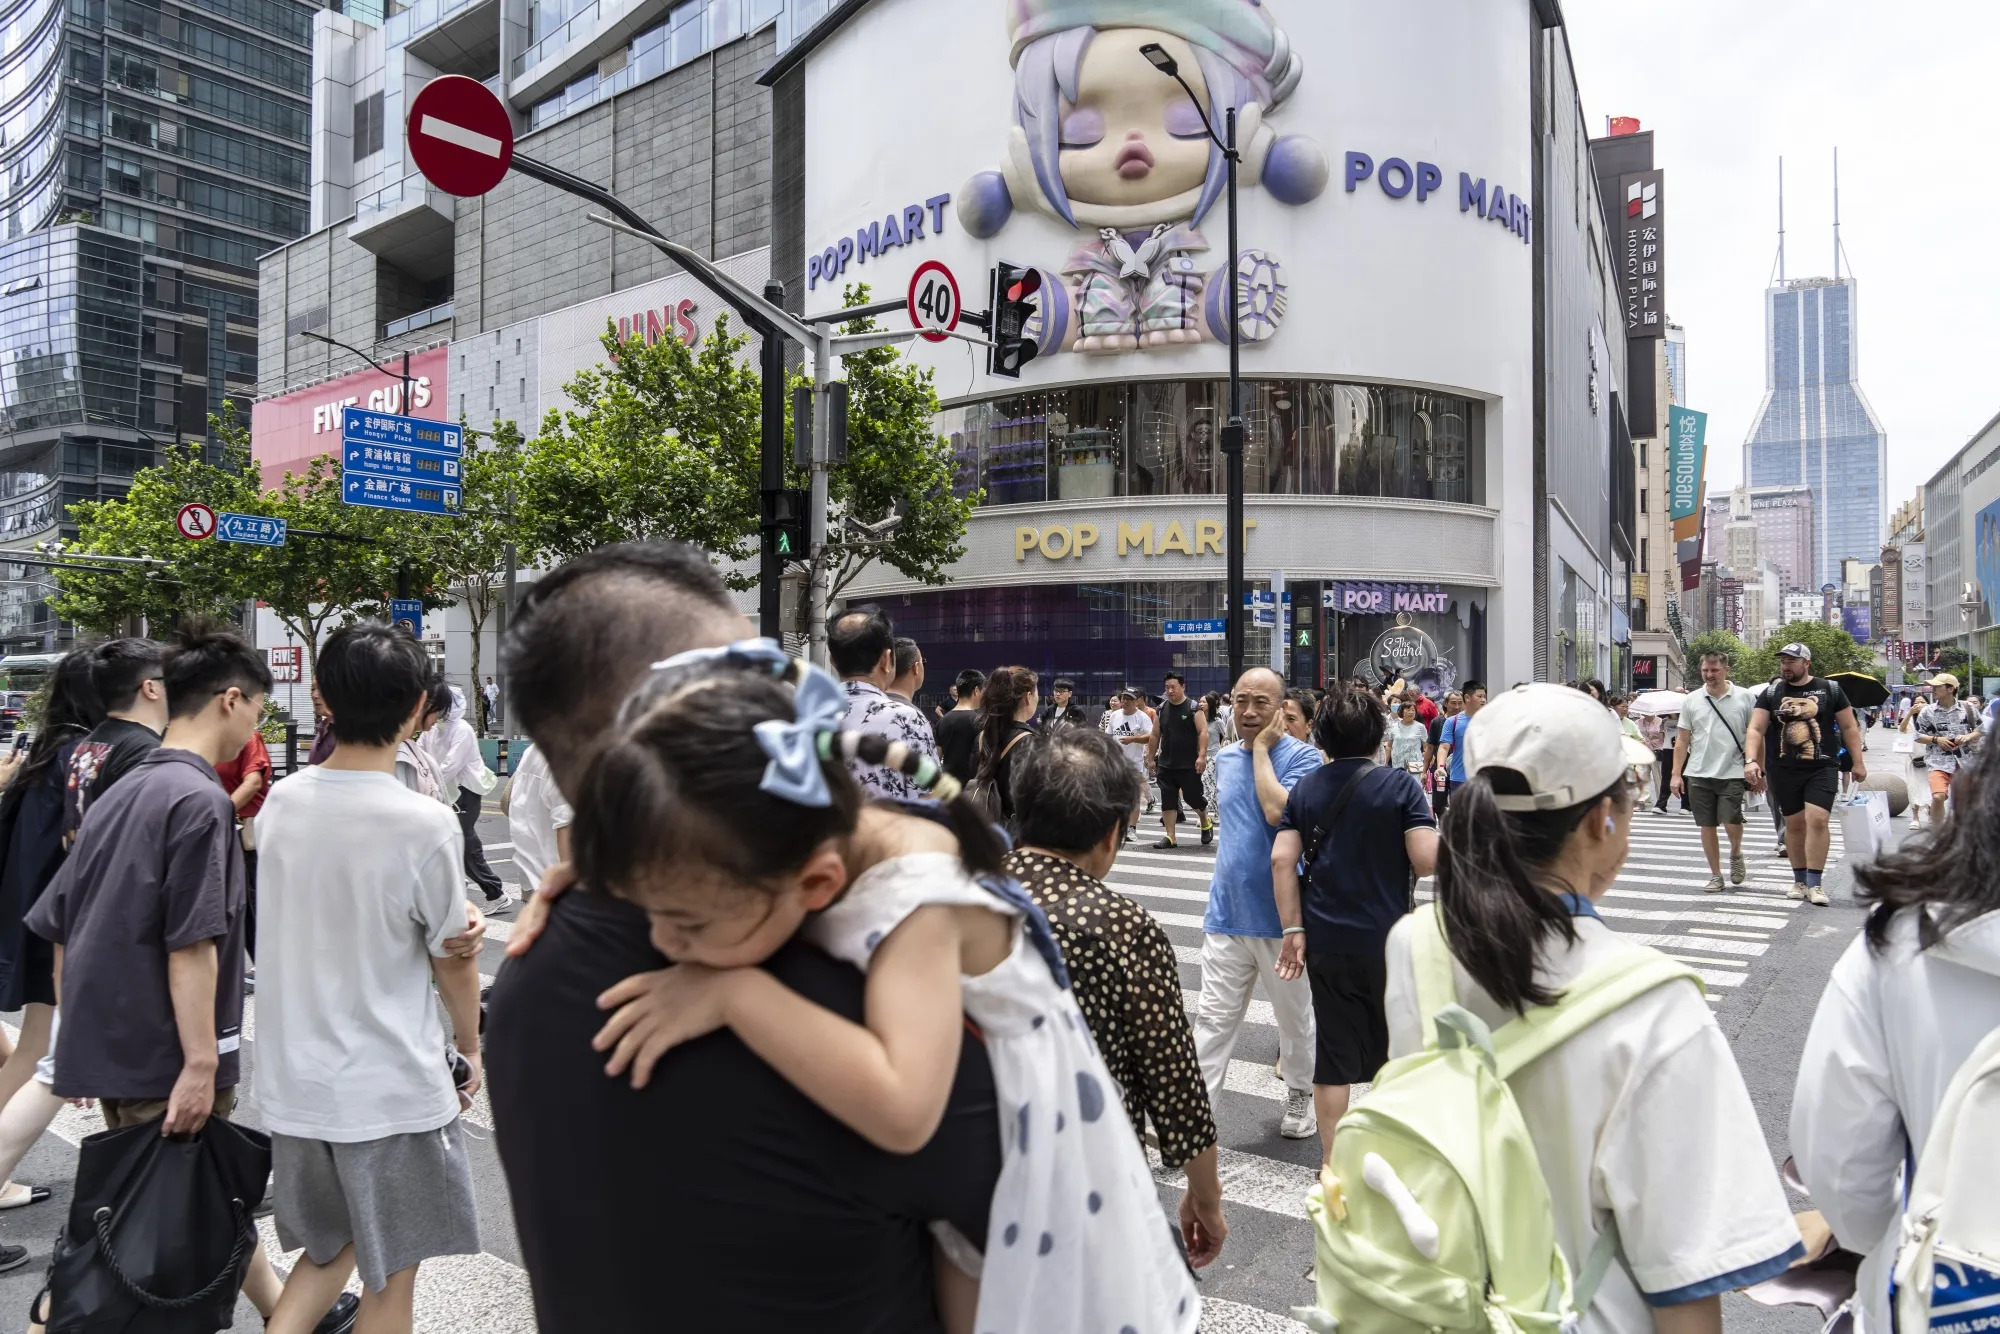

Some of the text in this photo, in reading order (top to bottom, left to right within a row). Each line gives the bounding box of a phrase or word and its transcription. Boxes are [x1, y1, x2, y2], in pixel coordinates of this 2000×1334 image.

[1345, 151, 1532, 244] POP MART
[809, 193, 951, 290] POP MART
[1628, 229, 1638, 329] HONGYI PLAZA
[1642, 227, 1658, 325] 宏伊国际广场
[919, 279, 949, 323] 40
[314, 396, 359, 434] FIV
[364, 417, 411, 434] 宏伊国际广场
[364, 430, 386, 438] Hongyi
[446, 433, 456, 445] P
[364, 447, 411, 465] 黄浦体育馆
[446, 463, 456, 475] P
[364, 478, 411, 495] 金融广场
[364, 492, 412, 503] Finance Square
[1772, 499, 1798, 507] PLAZA
[232, 520, 271, 533] 九江路
[234, 531, 257, 539] Jiujiang
[1015, 523, 1098, 561] POP
[394, 603, 420, 612] 九江路口
[1344, 590, 1448, 612] POP MART
[1178, 622, 1212, 632] 河南中路
[1381, 636, 1423, 658] Sound
[1394, 636, 1410, 648] The
[272, 649, 296, 664] FIVE
[272, 665, 299, 680] GUYS
